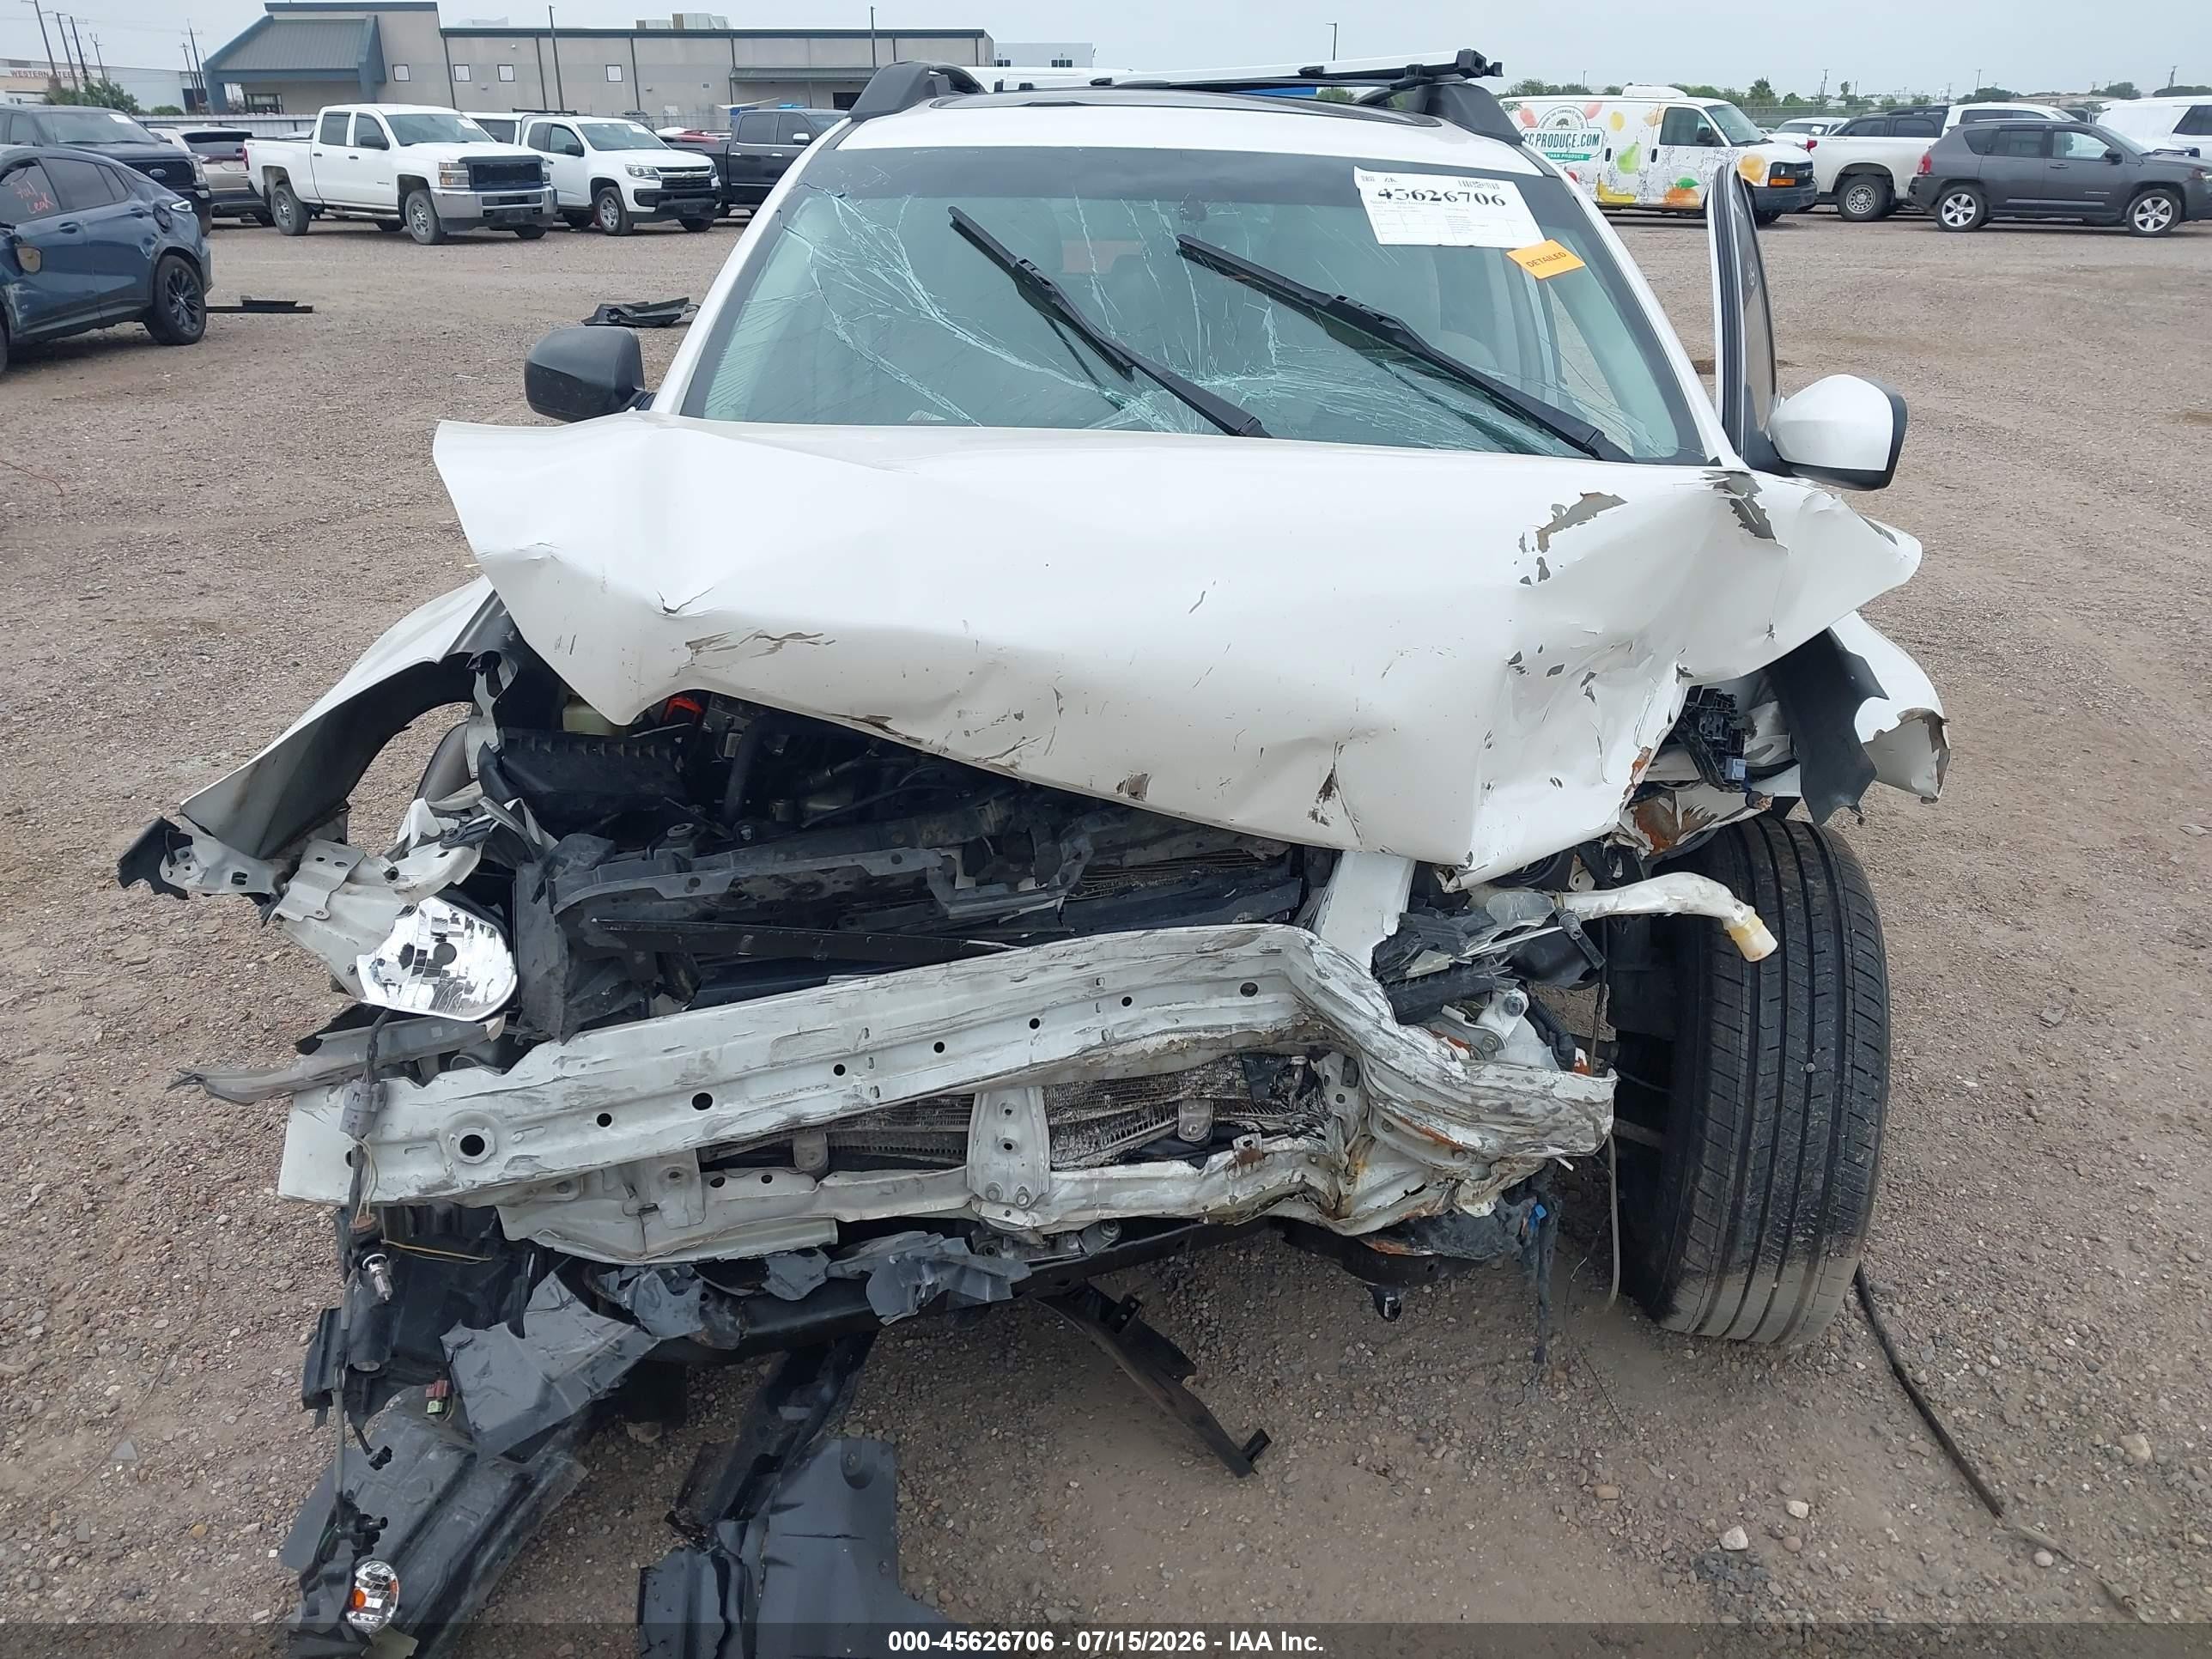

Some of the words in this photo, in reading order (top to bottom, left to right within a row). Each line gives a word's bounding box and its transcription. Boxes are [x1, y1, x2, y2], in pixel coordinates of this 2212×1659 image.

[9, 70, 50, 79] WESTERN
[1377, 188, 1506, 207] 45626706
[1525, 251, 1567, 268] DETAILED
